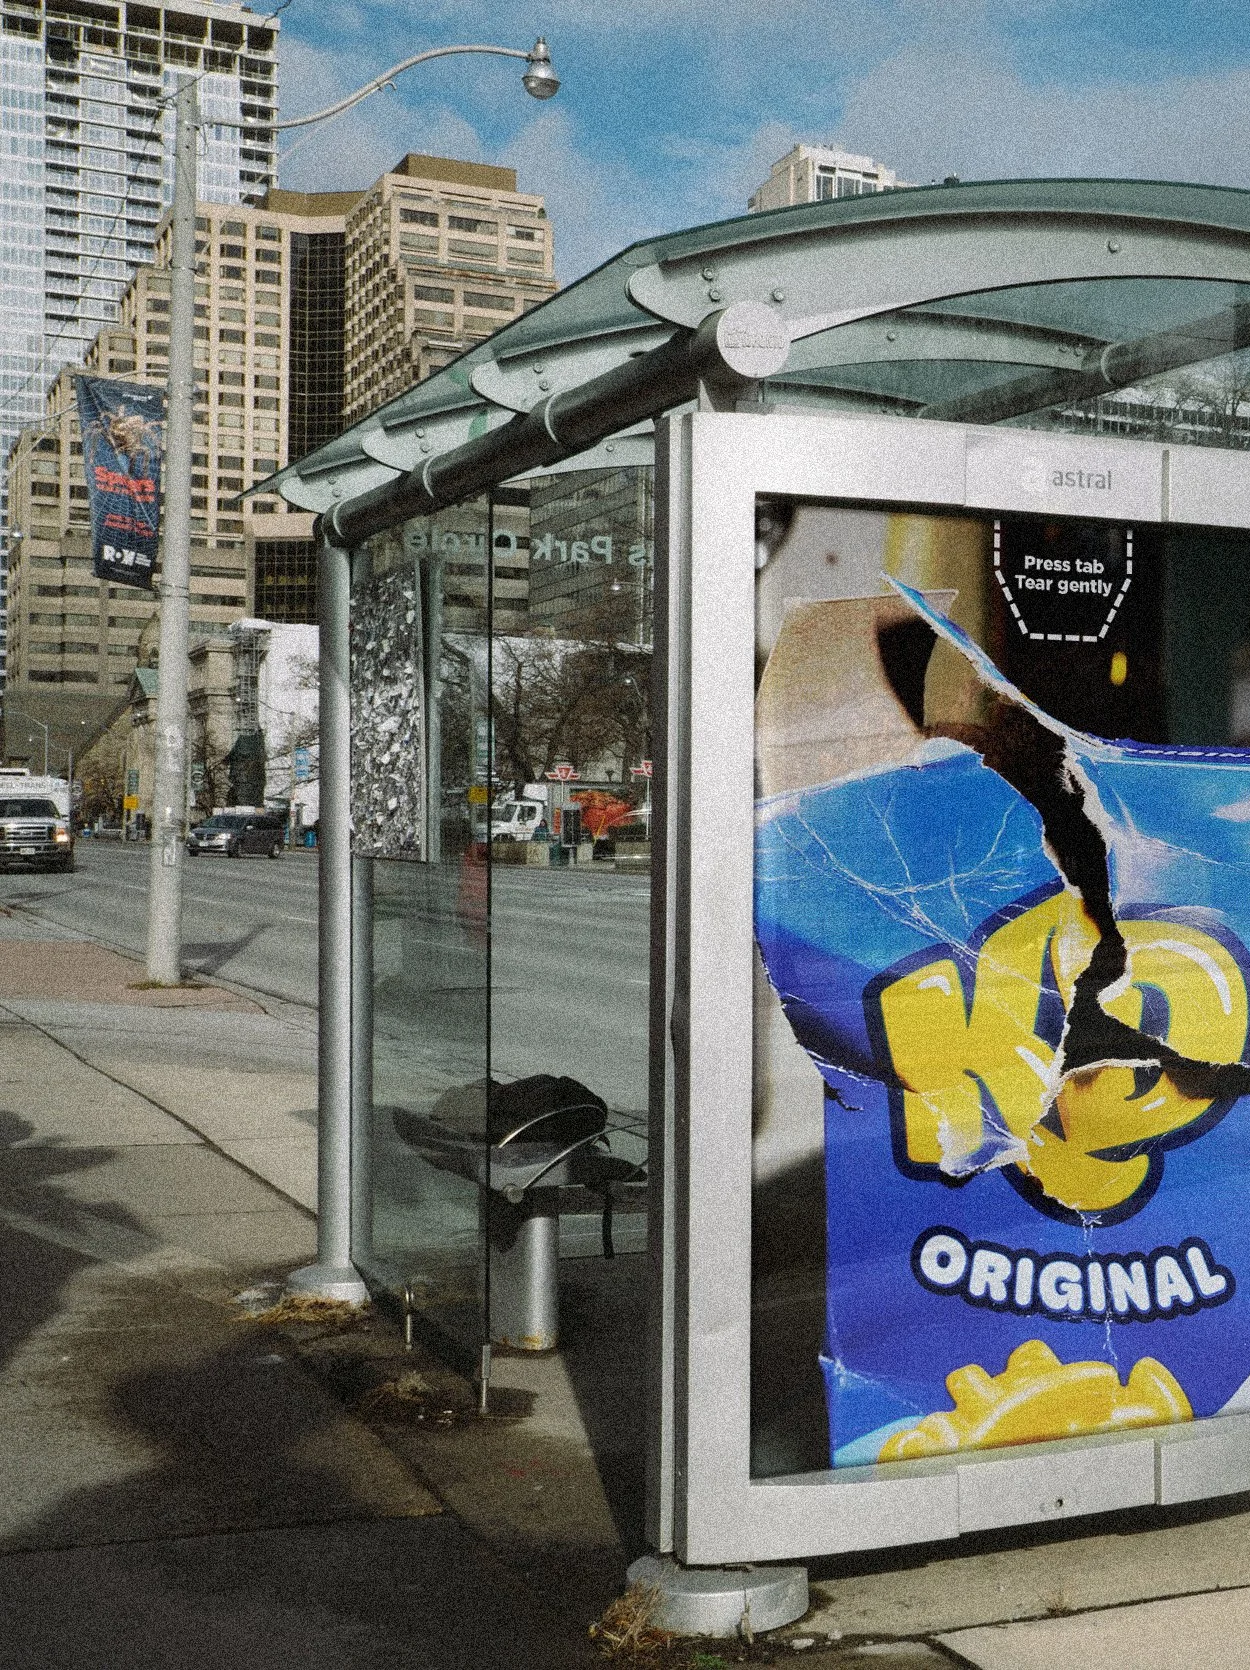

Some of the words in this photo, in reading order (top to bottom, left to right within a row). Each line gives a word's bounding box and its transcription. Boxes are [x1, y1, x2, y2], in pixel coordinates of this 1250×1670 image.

[1052, 470, 1112, 490] astral
[1024, 555, 1071, 572] Press
[1075, 558, 1104, 574] tab
[1014, 574, 1053, 591] Tear
[1057, 578, 1113, 597] gently
[918, 1233, 1229, 1316] ORIGINAL
